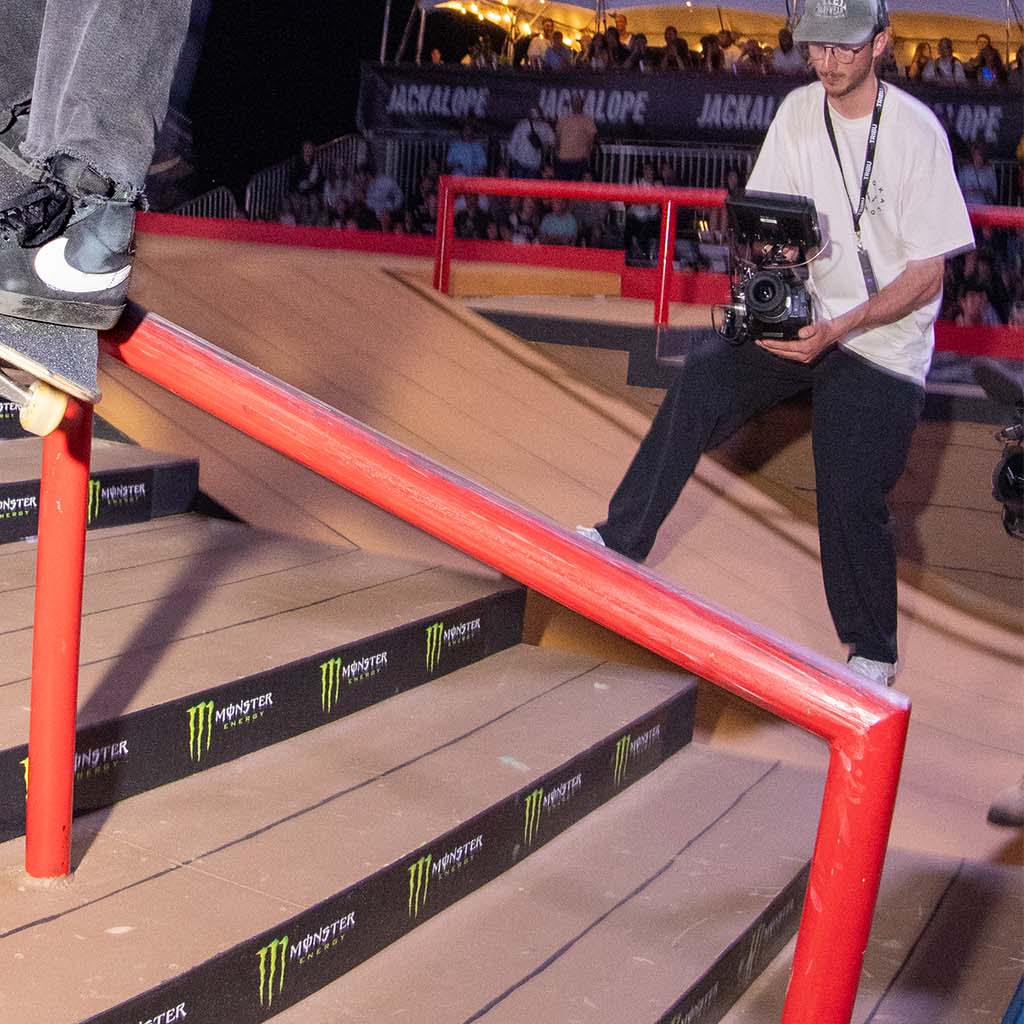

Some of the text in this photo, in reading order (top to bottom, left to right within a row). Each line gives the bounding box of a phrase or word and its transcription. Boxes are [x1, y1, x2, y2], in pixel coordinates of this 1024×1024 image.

[387, 83, 490, 119] JACKALOPE
[538, 88, 649, 124] JACALOPE
[696, 93, 774, 130] JACKAL
[223, 711, 264, 730] ENERGY
[77, 761, 118, 780] NERGY
[299, 933, 347, 965] ENERGY
